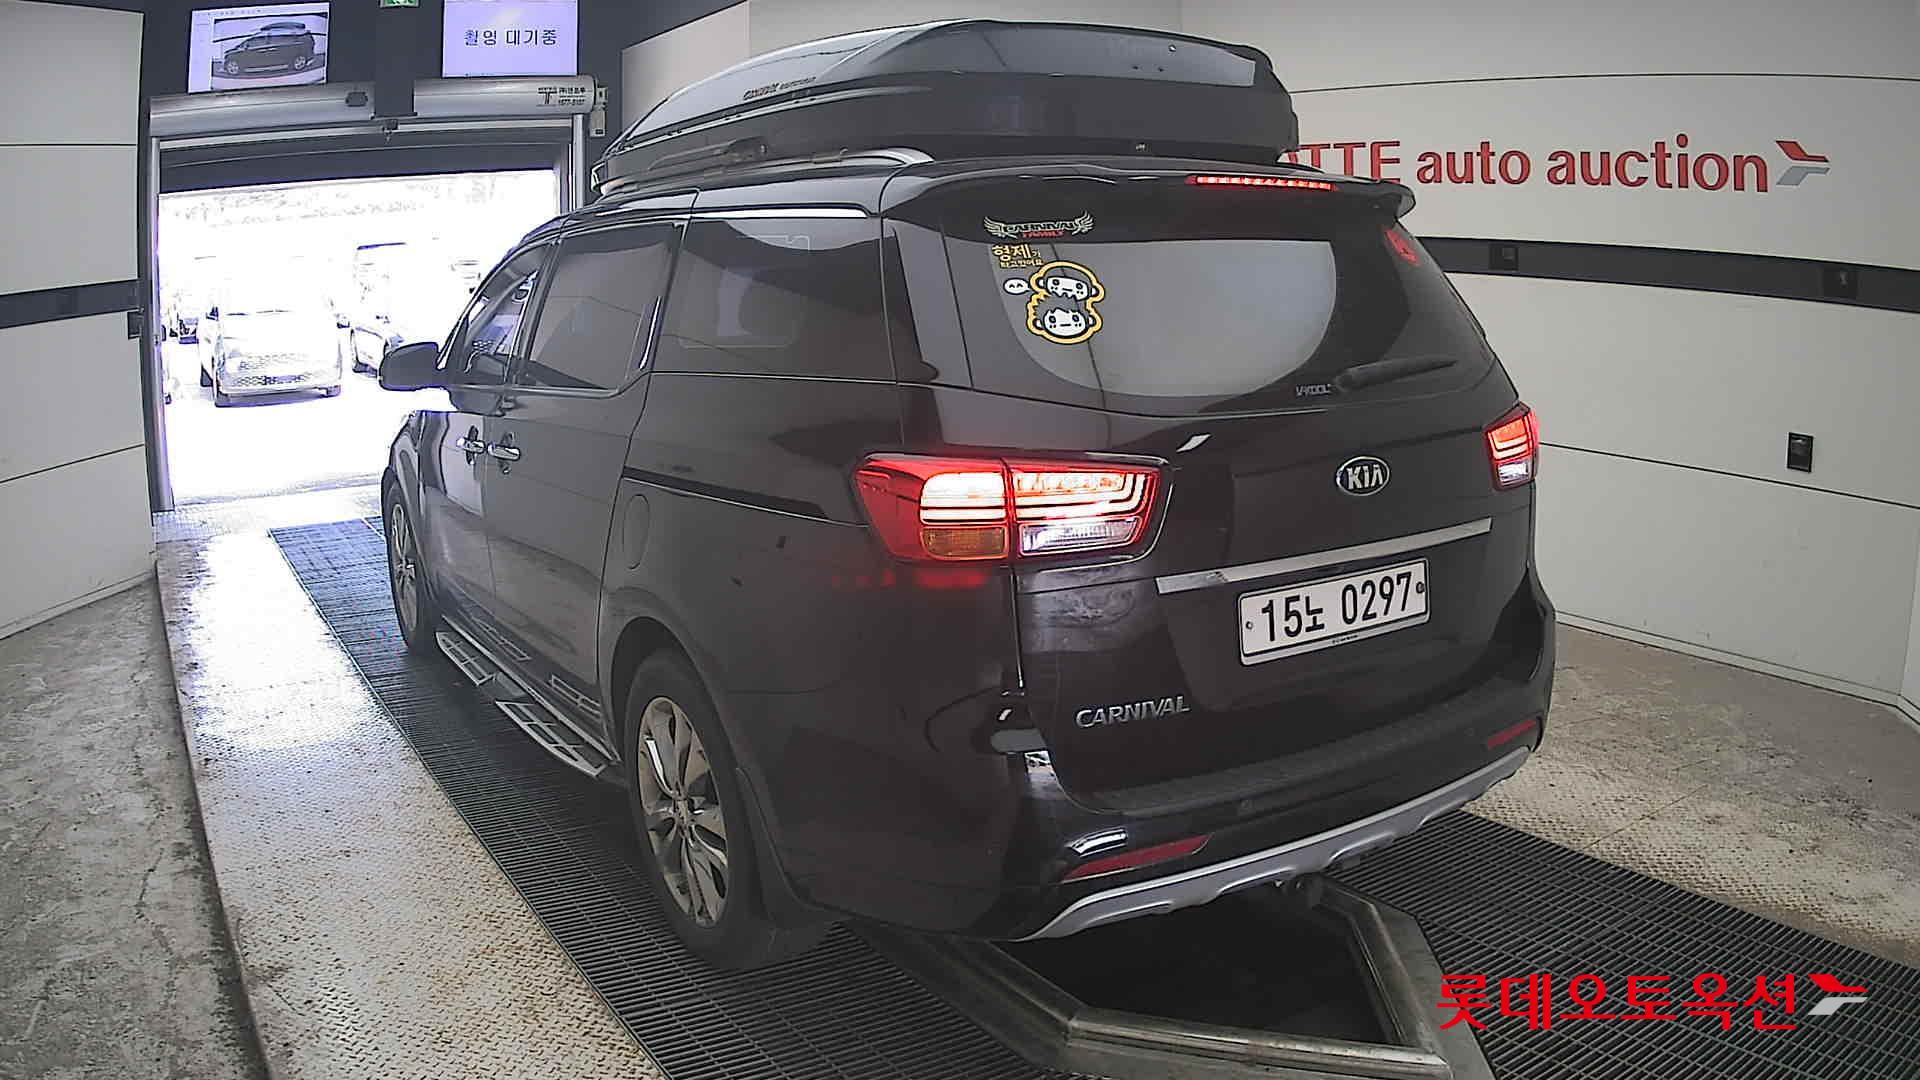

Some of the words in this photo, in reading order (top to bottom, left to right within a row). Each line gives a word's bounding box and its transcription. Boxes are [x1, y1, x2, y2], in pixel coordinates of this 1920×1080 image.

[505, 29, 558, 46] 대기중
[1416, 140, 1531, 185] auto
[1546, 134, 1768, 192] auction
[1345, 463, 1384, 490] KIA
[1261, 594, 1325, 642] 15노
[1341, 571, 1412, 625] 0297
[1075, 695, 1191, 728] CARNIVAL
